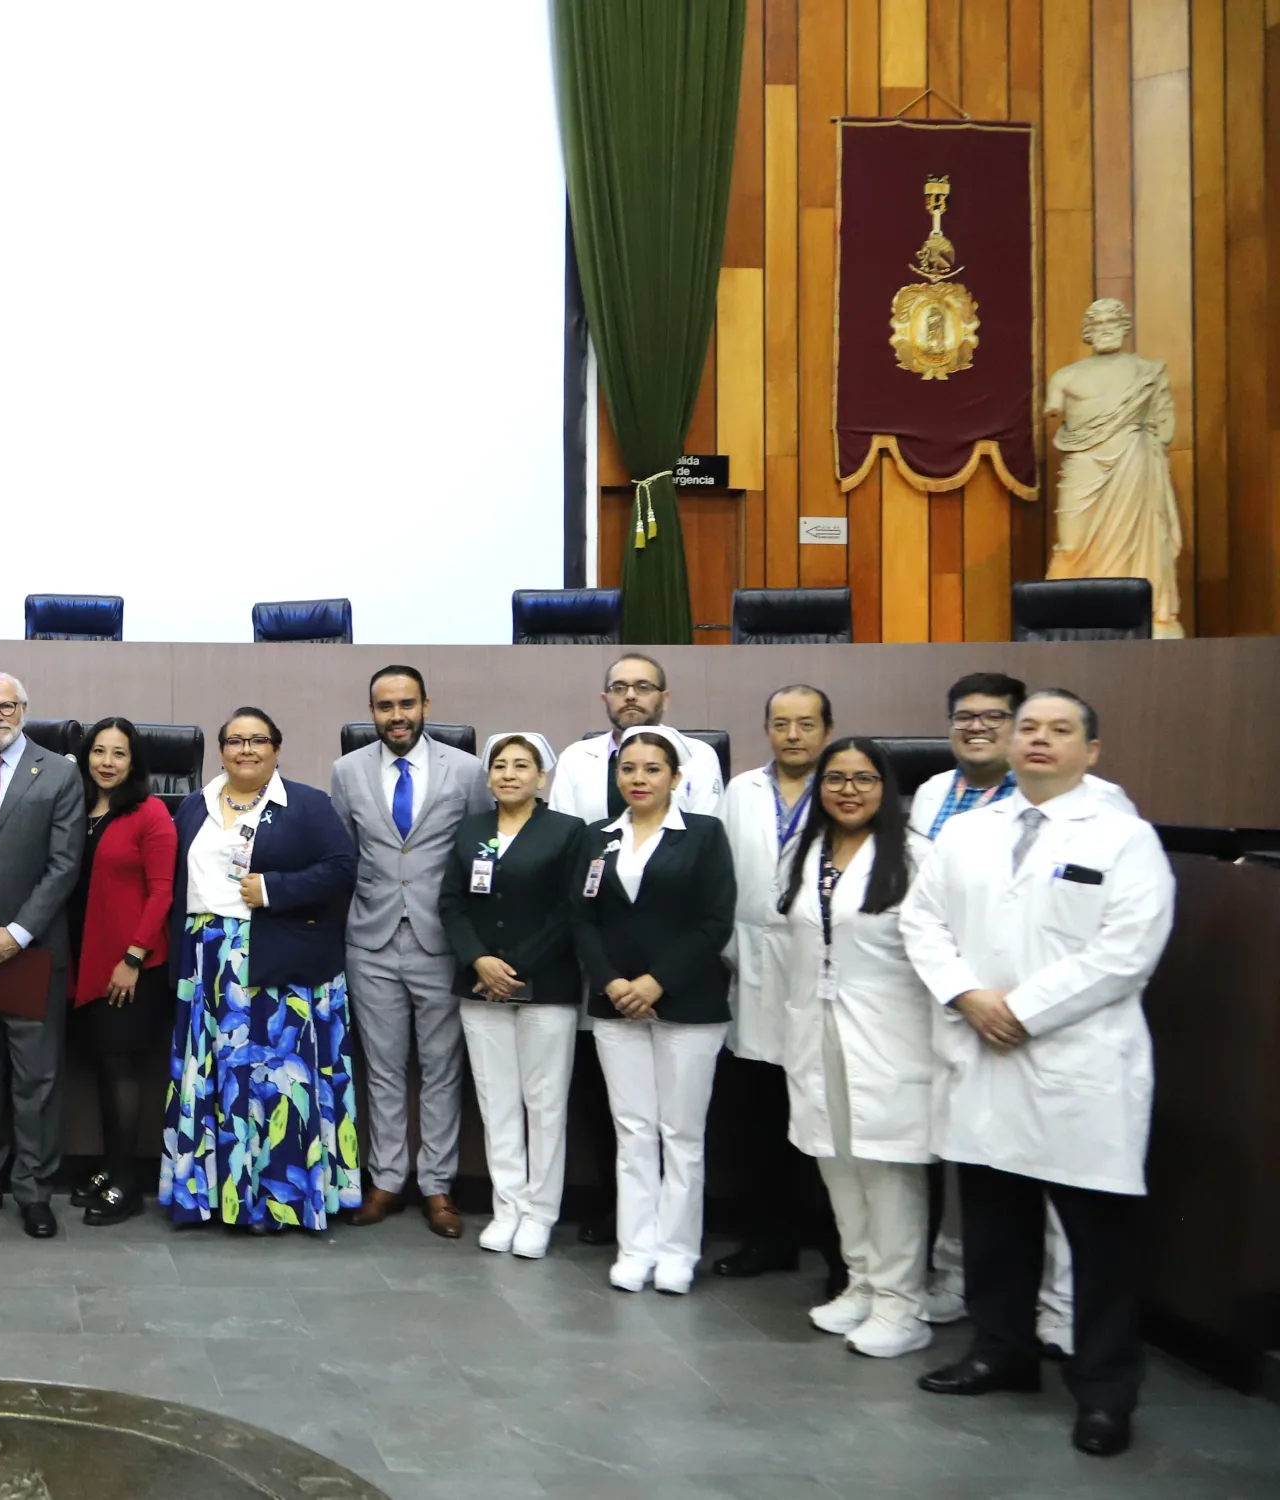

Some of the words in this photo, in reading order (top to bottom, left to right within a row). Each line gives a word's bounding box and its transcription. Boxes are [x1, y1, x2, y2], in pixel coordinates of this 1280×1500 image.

[676, 455, 700, 466] alida
[676, 466, 691, 476] de
[672, 475, 715, 486] ergencia
